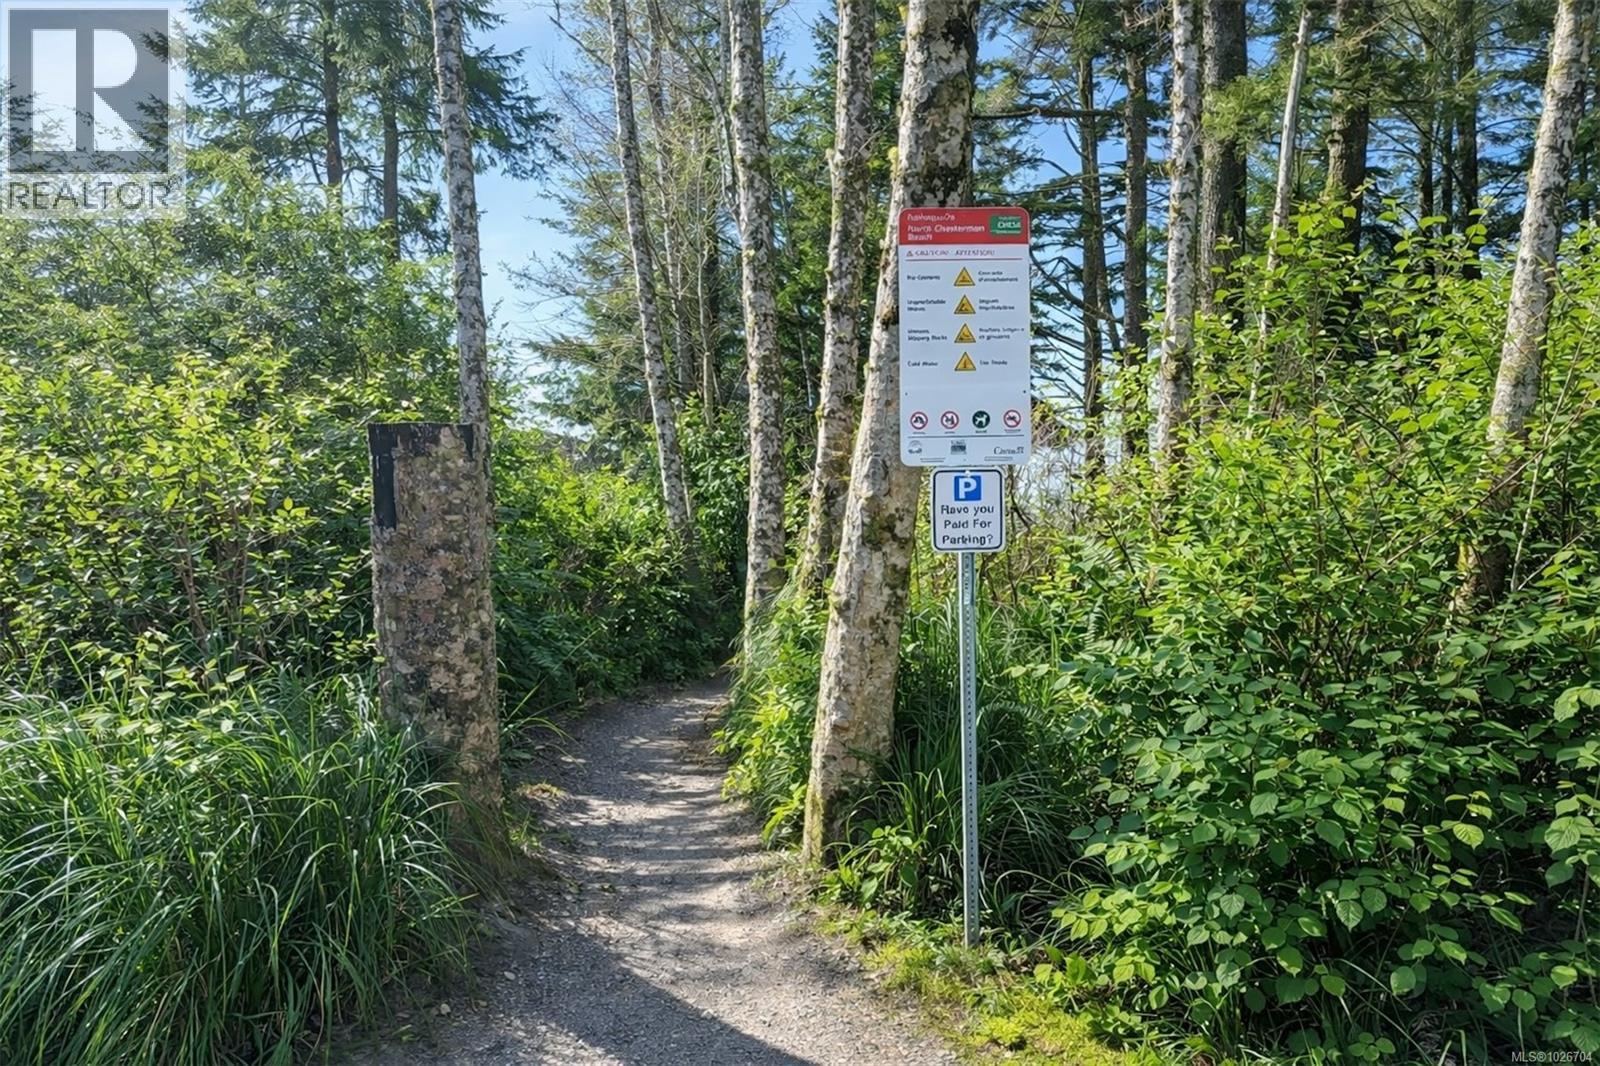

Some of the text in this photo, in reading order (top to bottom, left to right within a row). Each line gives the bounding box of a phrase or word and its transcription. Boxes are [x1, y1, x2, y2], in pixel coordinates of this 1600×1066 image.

[958, 477, 978, 500] P
[973, 505, 995, 517] you
[973, 518, 993, 529] For
[942, 533, 994, 546] Parking?
